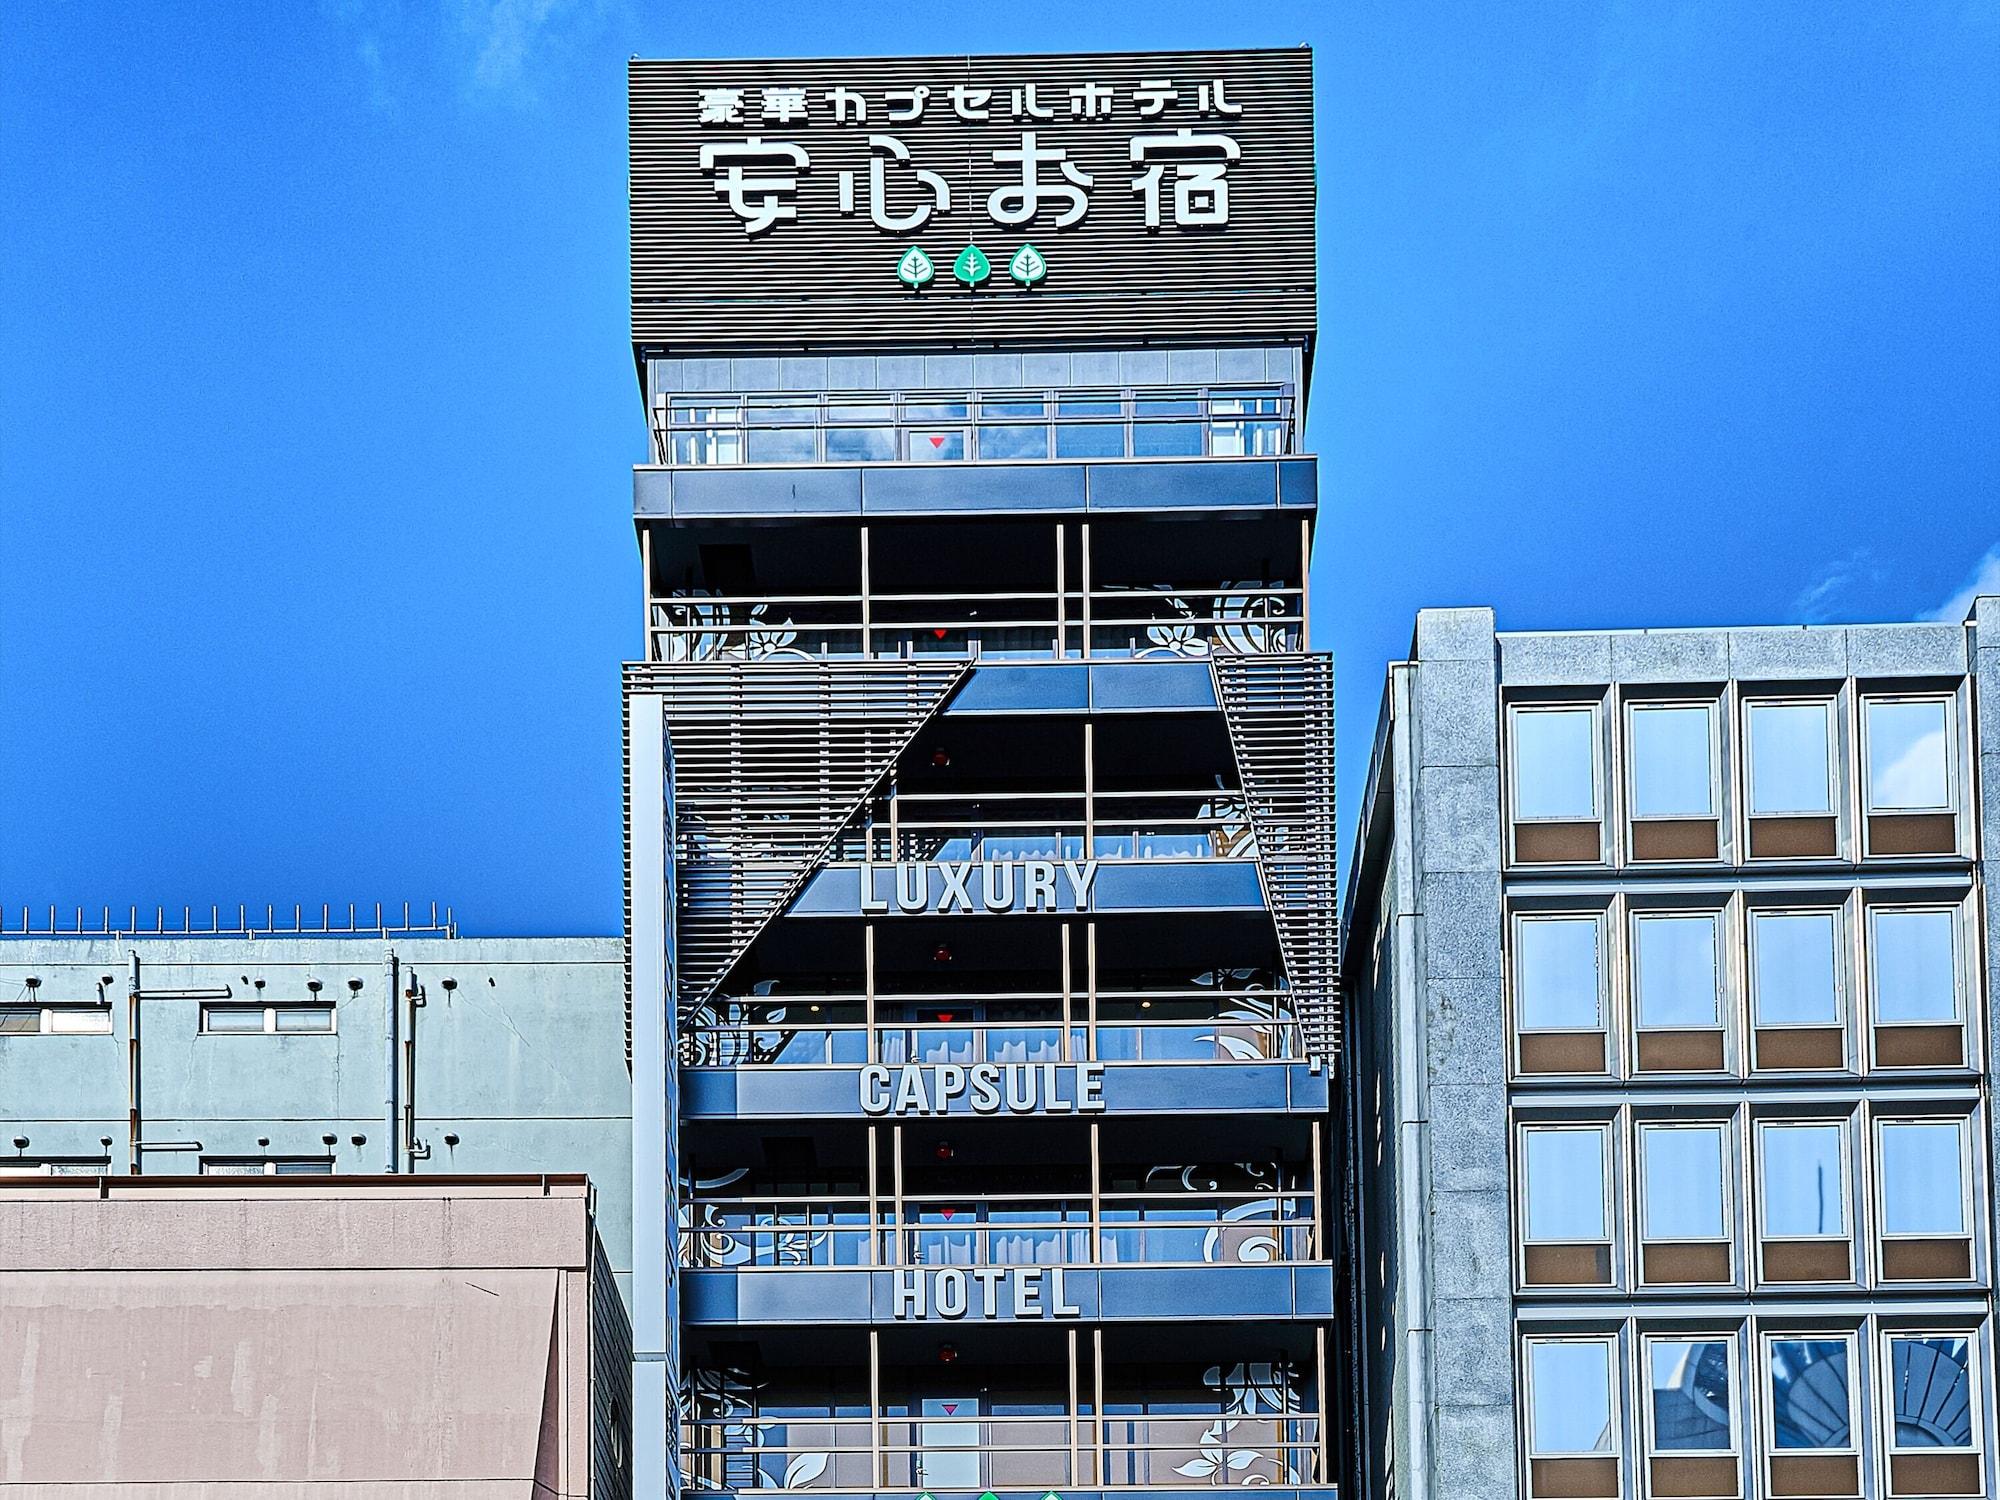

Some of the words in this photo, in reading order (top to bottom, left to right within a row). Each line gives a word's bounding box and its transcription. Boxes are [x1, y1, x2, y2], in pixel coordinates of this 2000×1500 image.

[698, 79, 1243, 124] 豪華カプセルホテル
[699, 127, 1242, 234] 安心お宿
[860, 860, 1098, 914] LUXURY
[859, 1063, 1106, 1115] CAPSULE
[893, 1267, 1081, 1319] HOTEL
